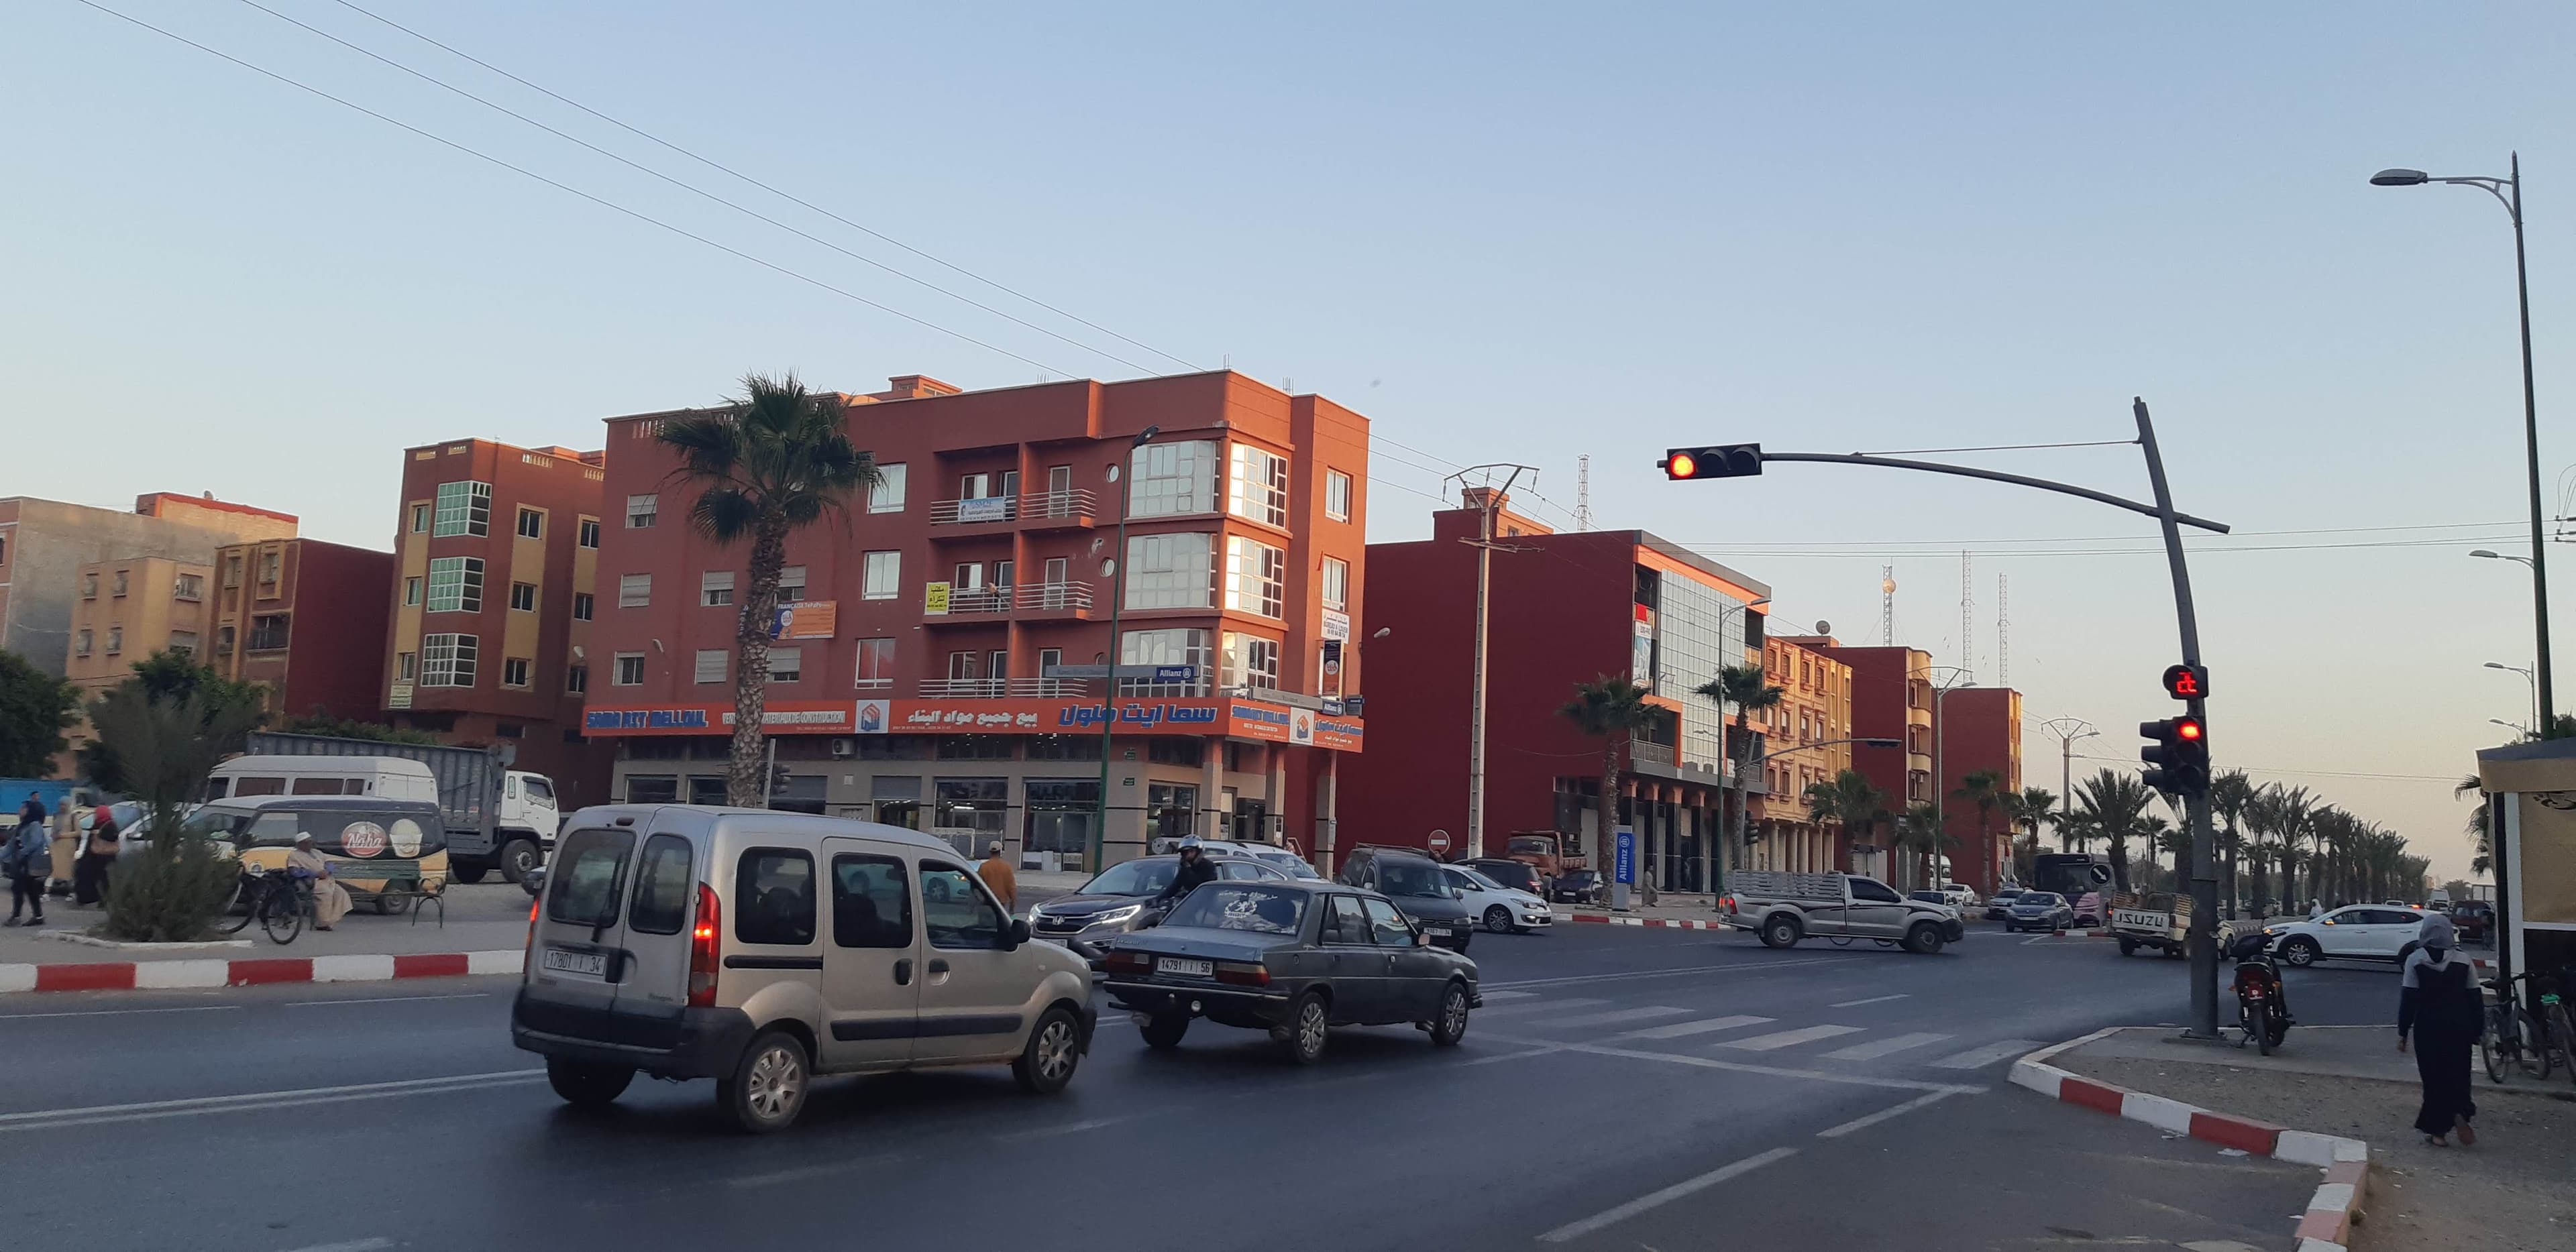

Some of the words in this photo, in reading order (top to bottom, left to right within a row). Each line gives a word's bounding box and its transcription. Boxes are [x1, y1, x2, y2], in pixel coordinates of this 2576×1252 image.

[1159, 669, 1182, 677] Allianz
[944, 710, 974, 725] مواد
[1167, 703, 1218, 723] سما
[1619, 849, 1628, 880] Allianz
[2114, 913, 2163, 927] ISUZU
[590, 956, 601, 972] 34
[1162, 960, 1181, 970] 14791
[1201, 962, 1210, 972] 56
